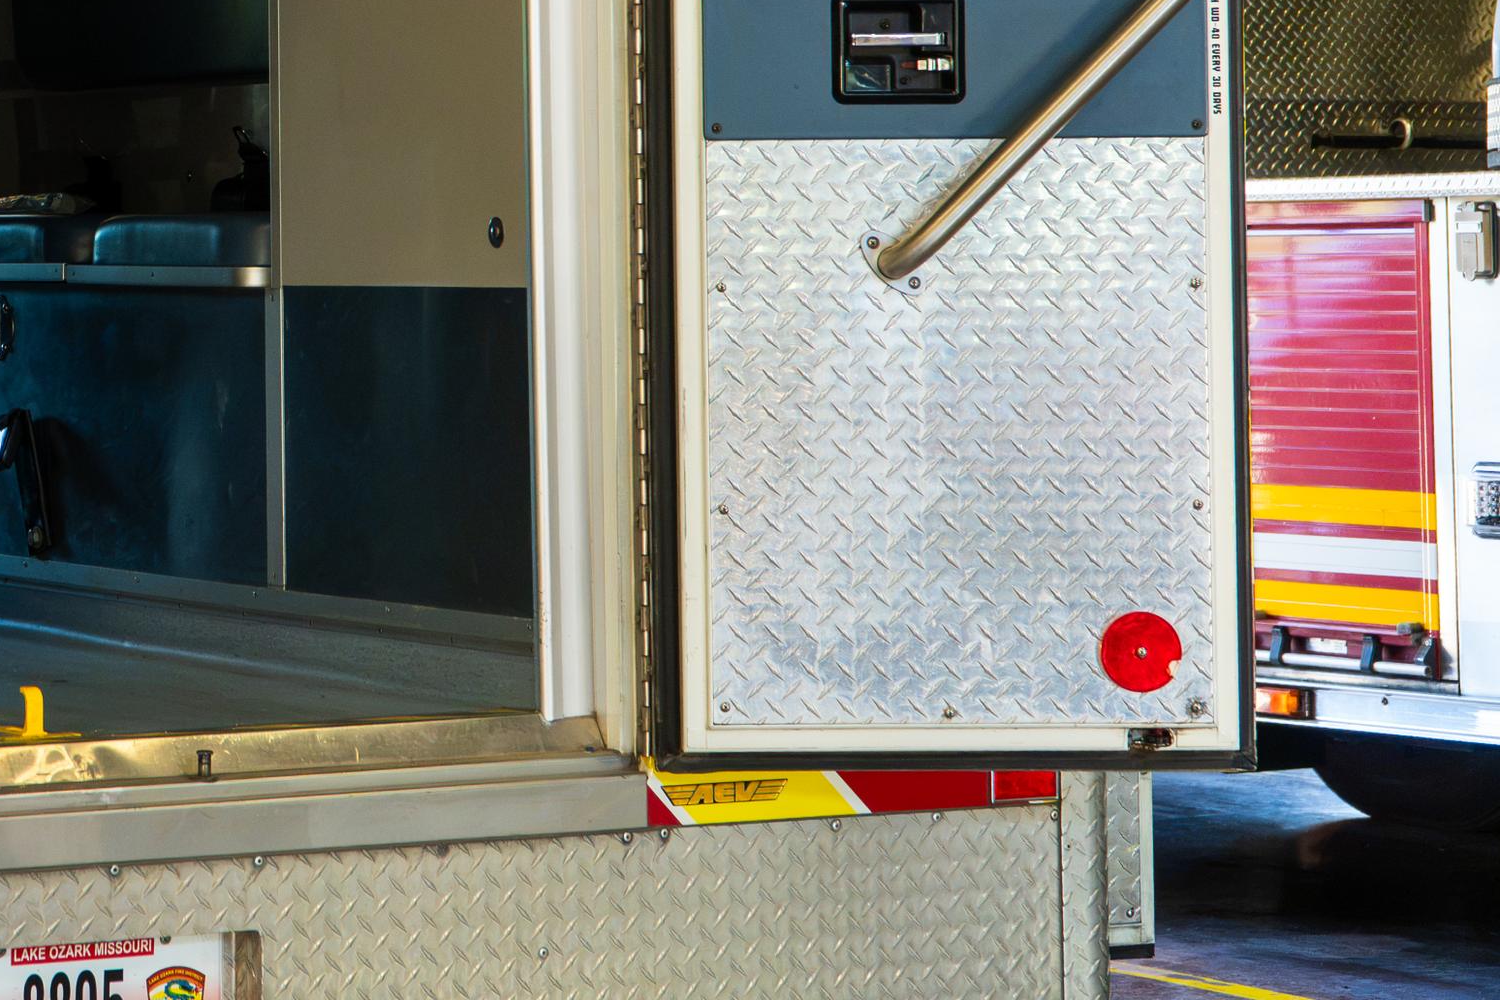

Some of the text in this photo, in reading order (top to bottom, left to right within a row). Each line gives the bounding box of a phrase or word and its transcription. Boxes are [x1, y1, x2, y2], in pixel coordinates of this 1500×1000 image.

[1211, 7, 1220, 40] WD-40
[1211, 43, 1221, 72] EVERY
[1212, 76, 1221, 88] 30
[1213, 91, 1222, 115] DAYS
[686, 779, 761, 806] AEV
[13, 939, 153, 962] LAKE OZARK MISSOURI
